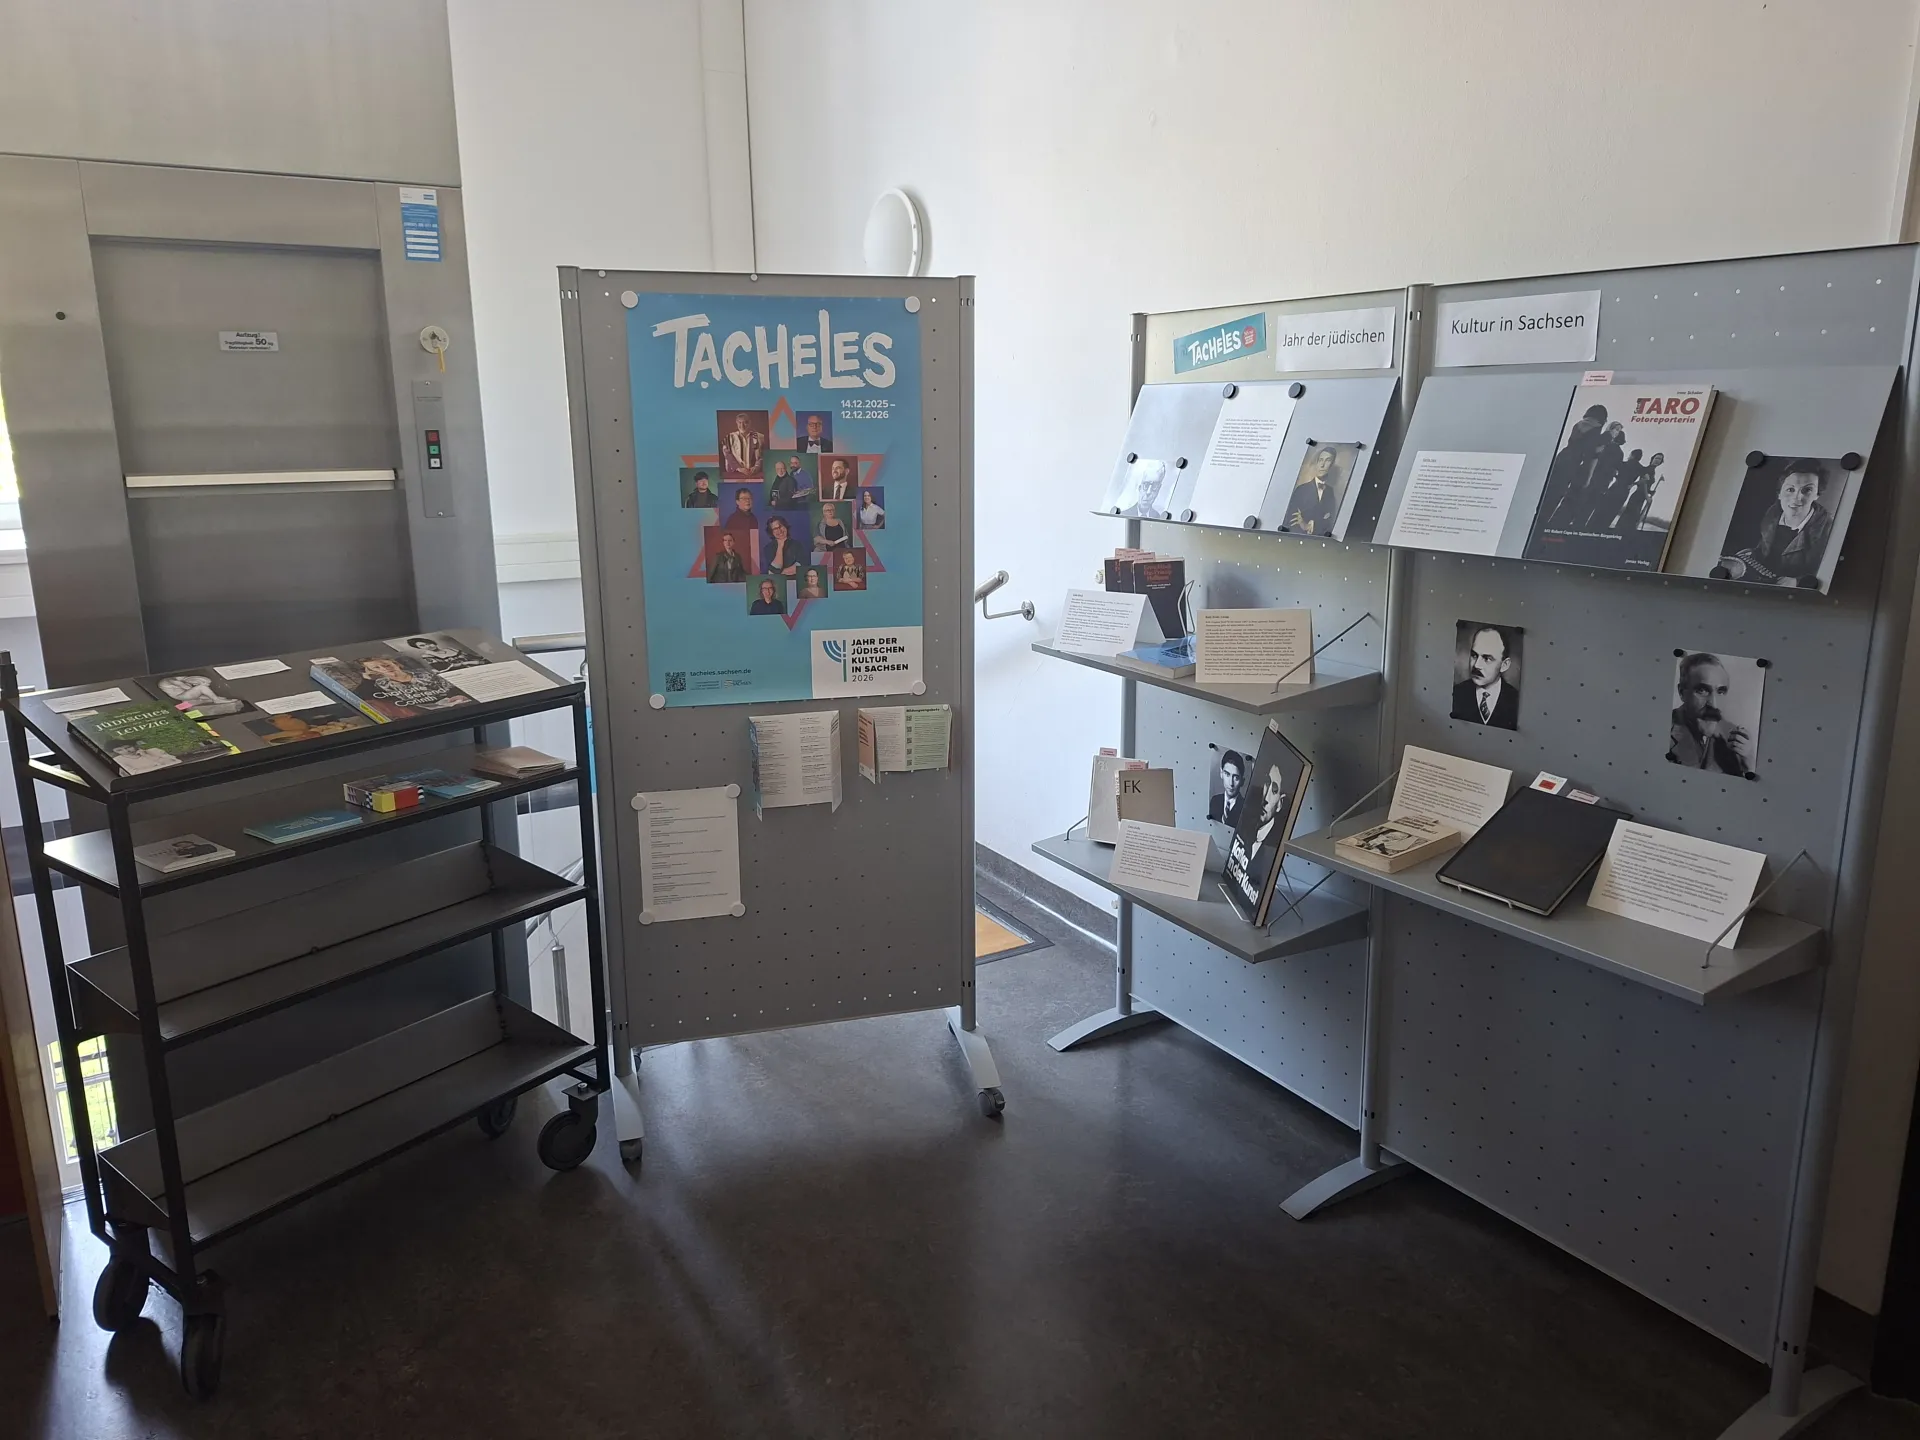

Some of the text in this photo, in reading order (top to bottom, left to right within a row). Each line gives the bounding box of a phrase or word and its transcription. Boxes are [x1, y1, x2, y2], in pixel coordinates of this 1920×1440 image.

[1451, 313, 1585, 335] Kultur in Sachsen
[255, 338, 267, 346] 50
[1283, 328, 1386, 349] Jahr der jüdischen
[652, 309, 896, 391] TACHELES
[1187, 327, 1242, 366] TACHELES
[1637, 397, 1700, 415] TARO
[840, 410, 889, 419] 12.12.2026
[1630, 415, 1695, 424] Fotoreporterin
[851, 637, 898, 646] JAHR DER
[851, 645, 905, 655] JÜDISCHEN
[851, 656, 888, 664] KULTUR
[690, 668, 752, 677] tacheles.sachsen.de
[851, 663, 909, 673] IN SACHSEN
[852, 674, 874, 682] 2026
[1123, 779, 1142, 794] FK
[1231, 838, 1249, 871] Kafka
